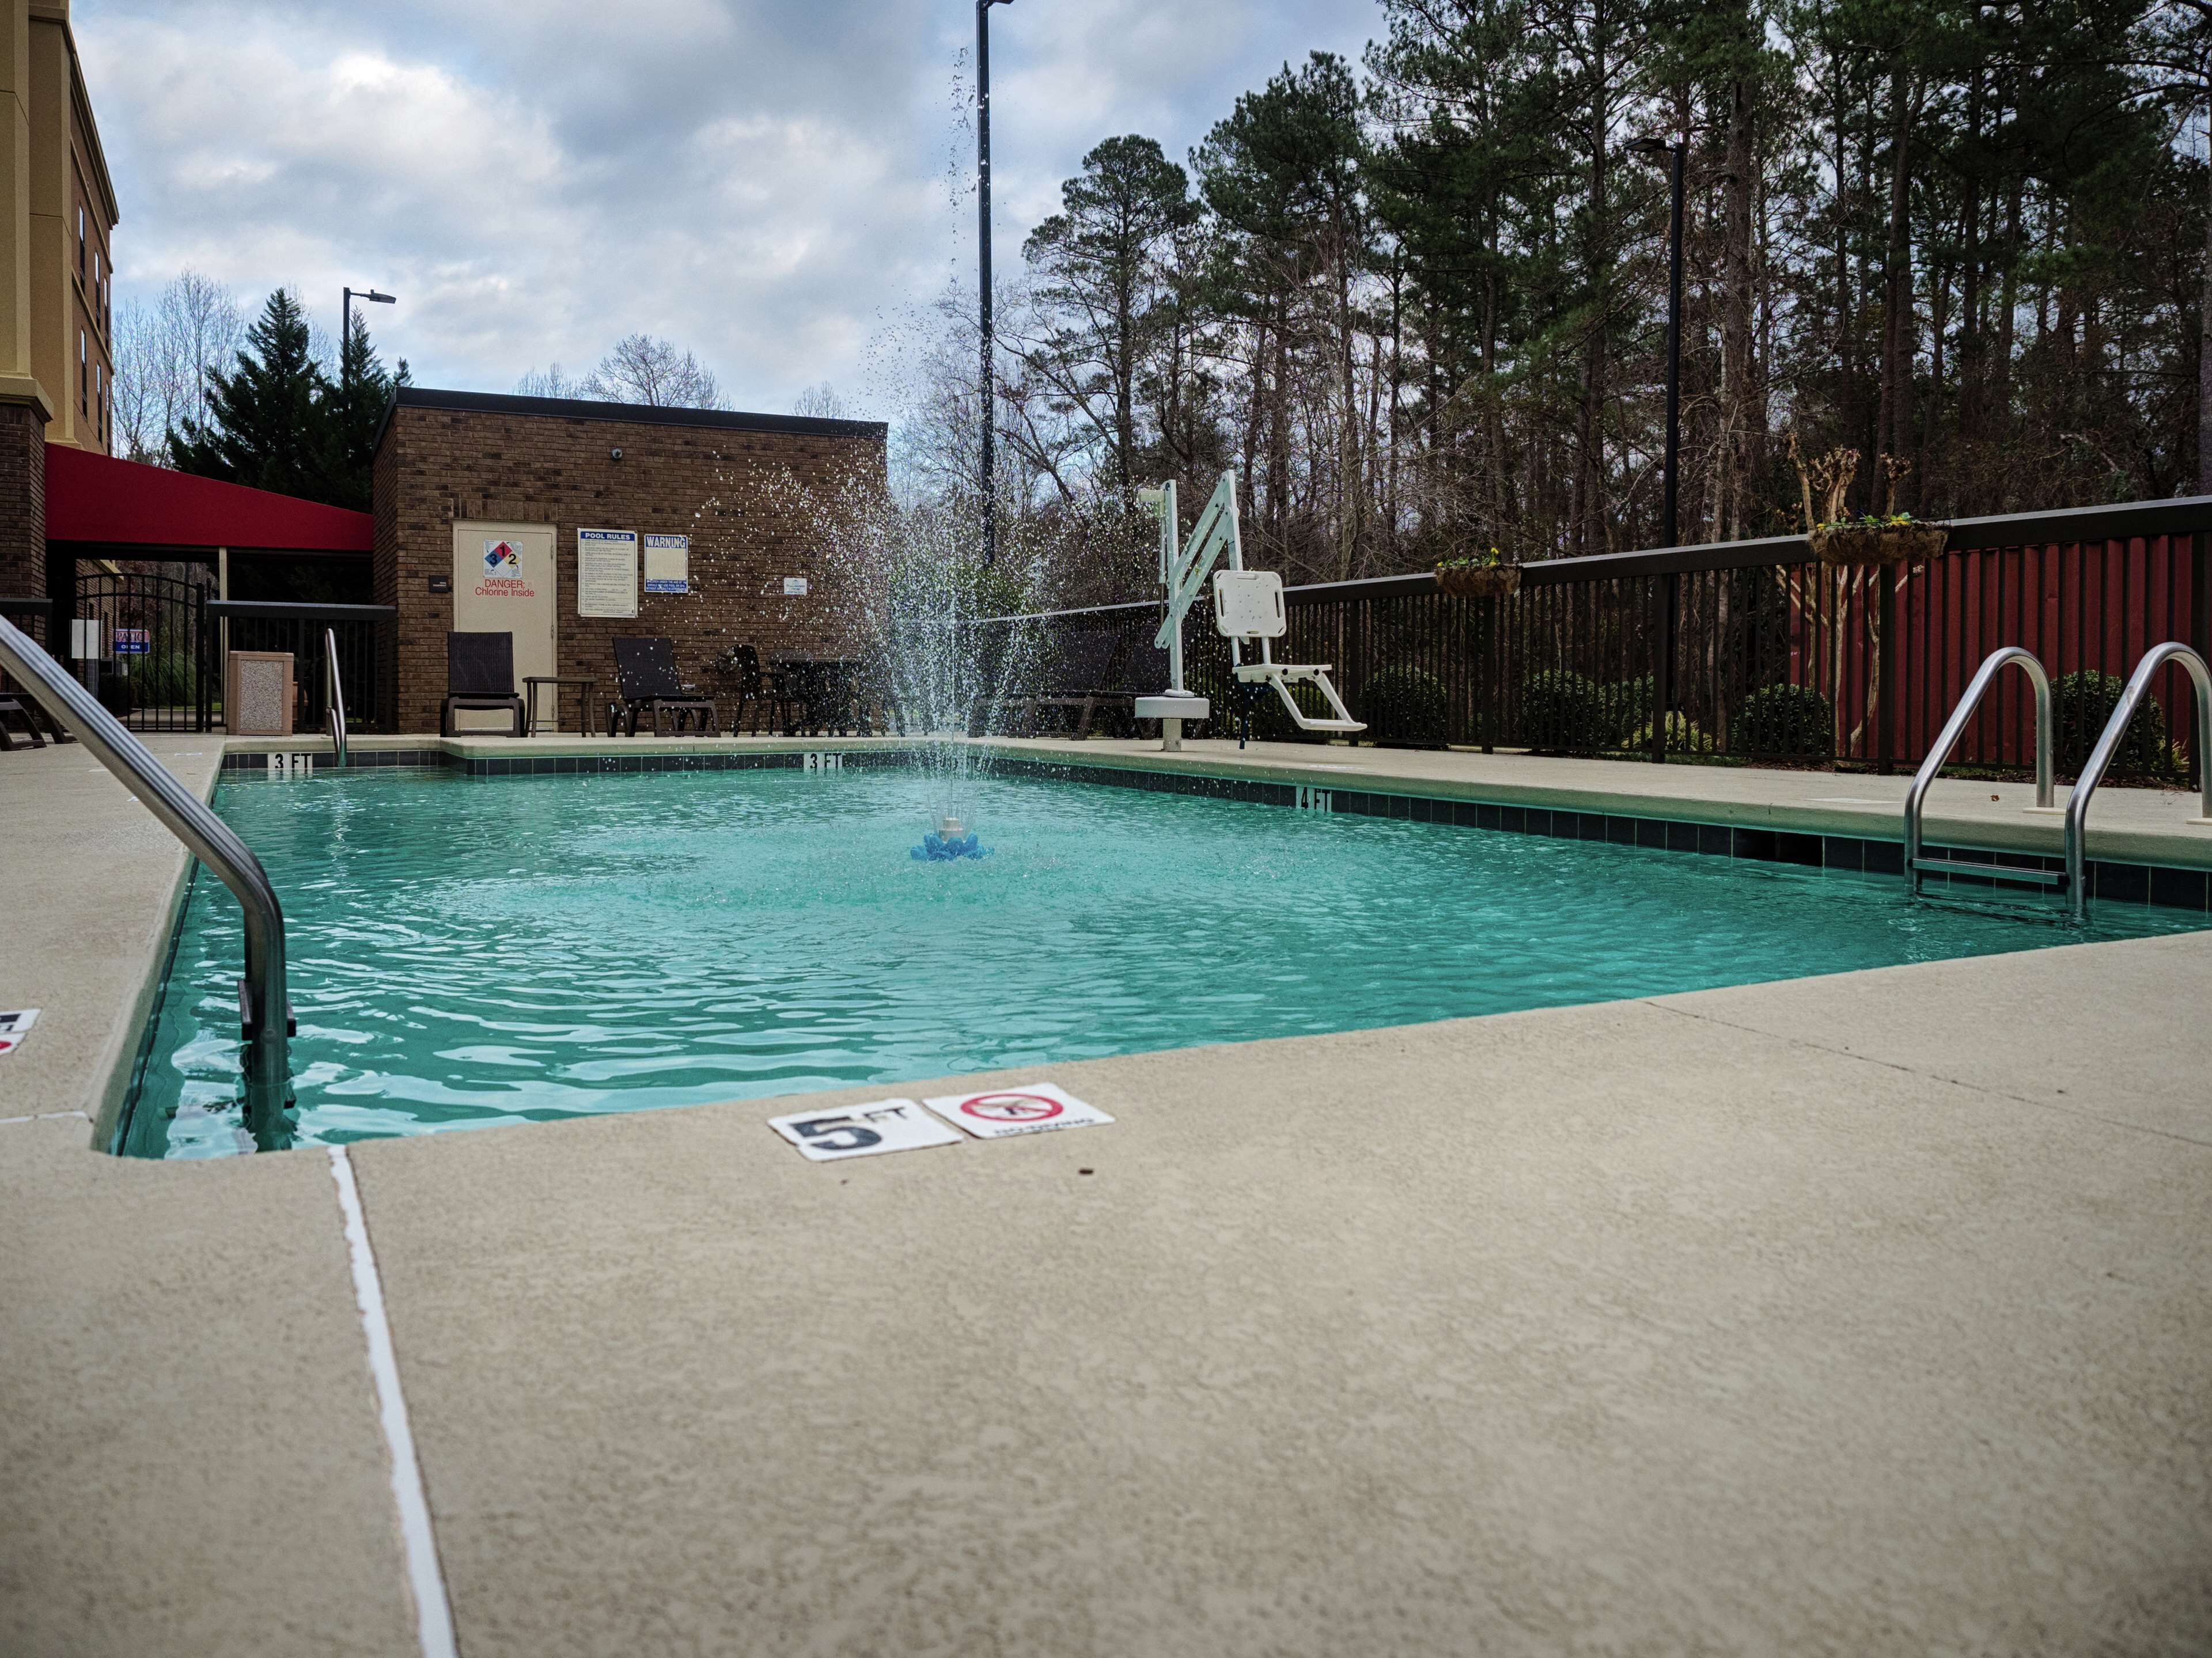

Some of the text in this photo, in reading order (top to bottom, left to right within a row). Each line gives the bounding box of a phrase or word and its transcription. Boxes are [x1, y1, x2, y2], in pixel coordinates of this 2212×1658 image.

[646, 536, 685, 548] WARNING
[500, 545, 505, 557] 1
[490, 554, 498, 564] 3
[509, 553, 517, 564] 2
[475, 587, 535, 597] Chlorine Inside
[275, 753, 311, 769] 3 FT
[810, 753, 842, 769] 3 FT
[1301, 787, 1330, 811] 4 FT
[789, 1107, 908, 1149] 5 FT
